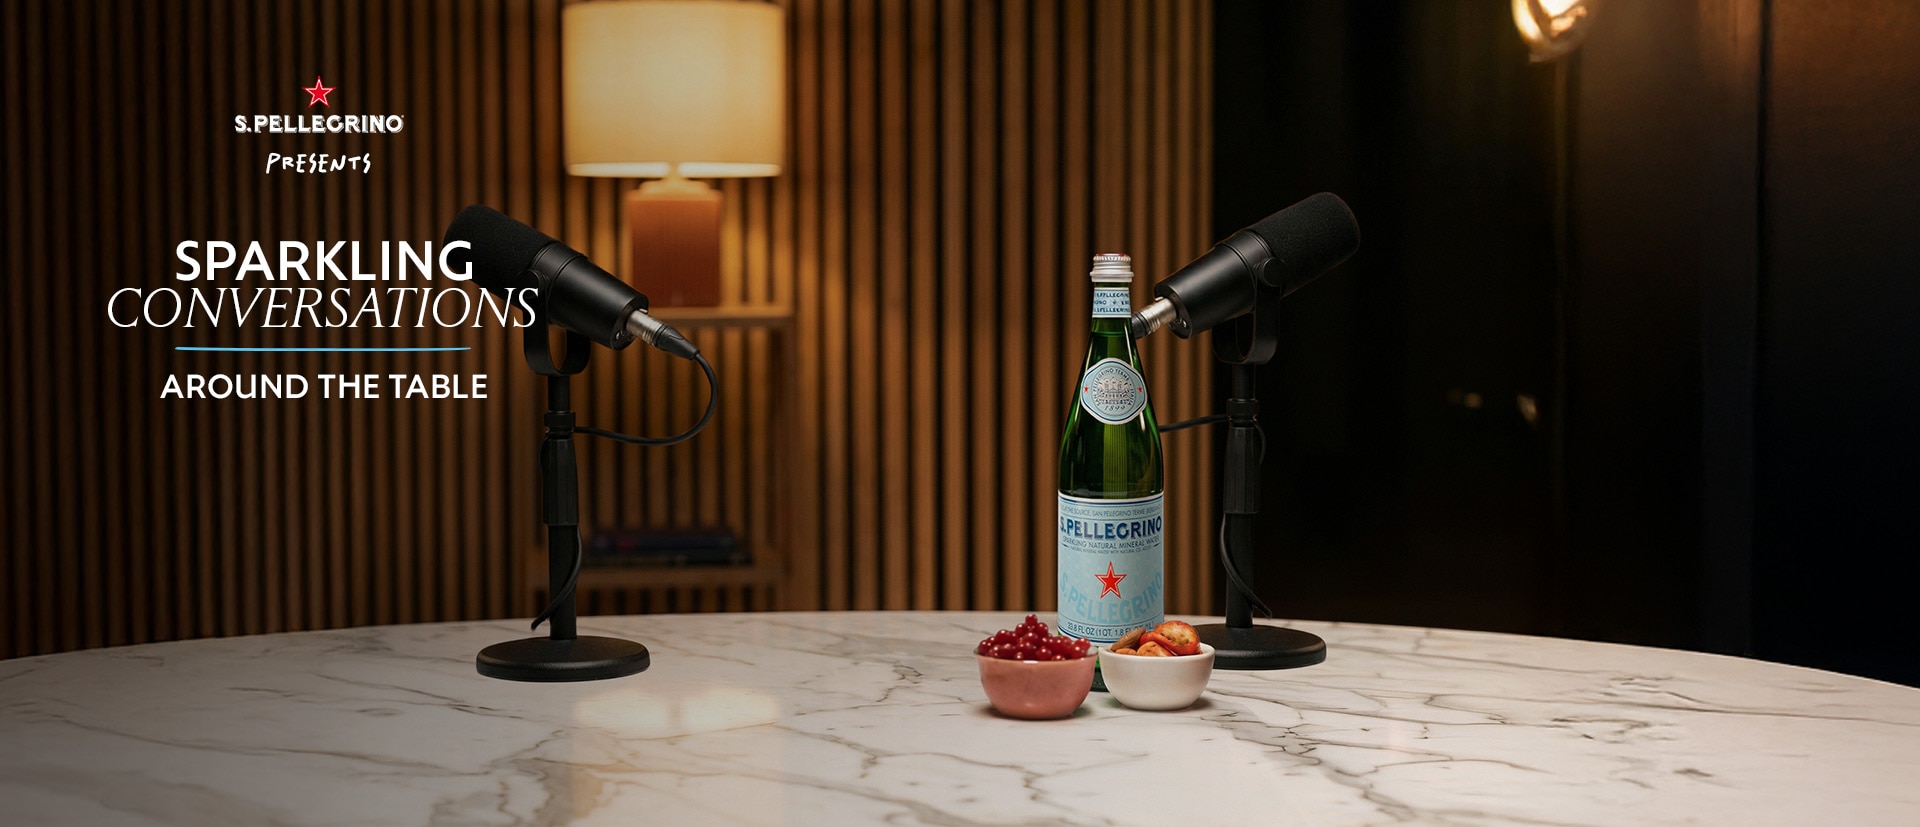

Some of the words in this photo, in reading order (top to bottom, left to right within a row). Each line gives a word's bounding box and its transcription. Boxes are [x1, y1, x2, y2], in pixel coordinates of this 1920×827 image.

[1060, 515, 1162, 540] S.PELLEGRINO
[1063, 535, 1087, 548] SPARKLING
[1088, 542, 1117, 550] NATURAL
[1118, 540, 1144, 549] MINERAL
[1146, 535, 1160, 545] WATER
[1059, 570, 1163, 624] S.PELLEGRINO
[1077, 625, 1085, 634] FL
[1086, 626, 1095, 636] OZ
[1114, 628, 1124, 636] 1.8
